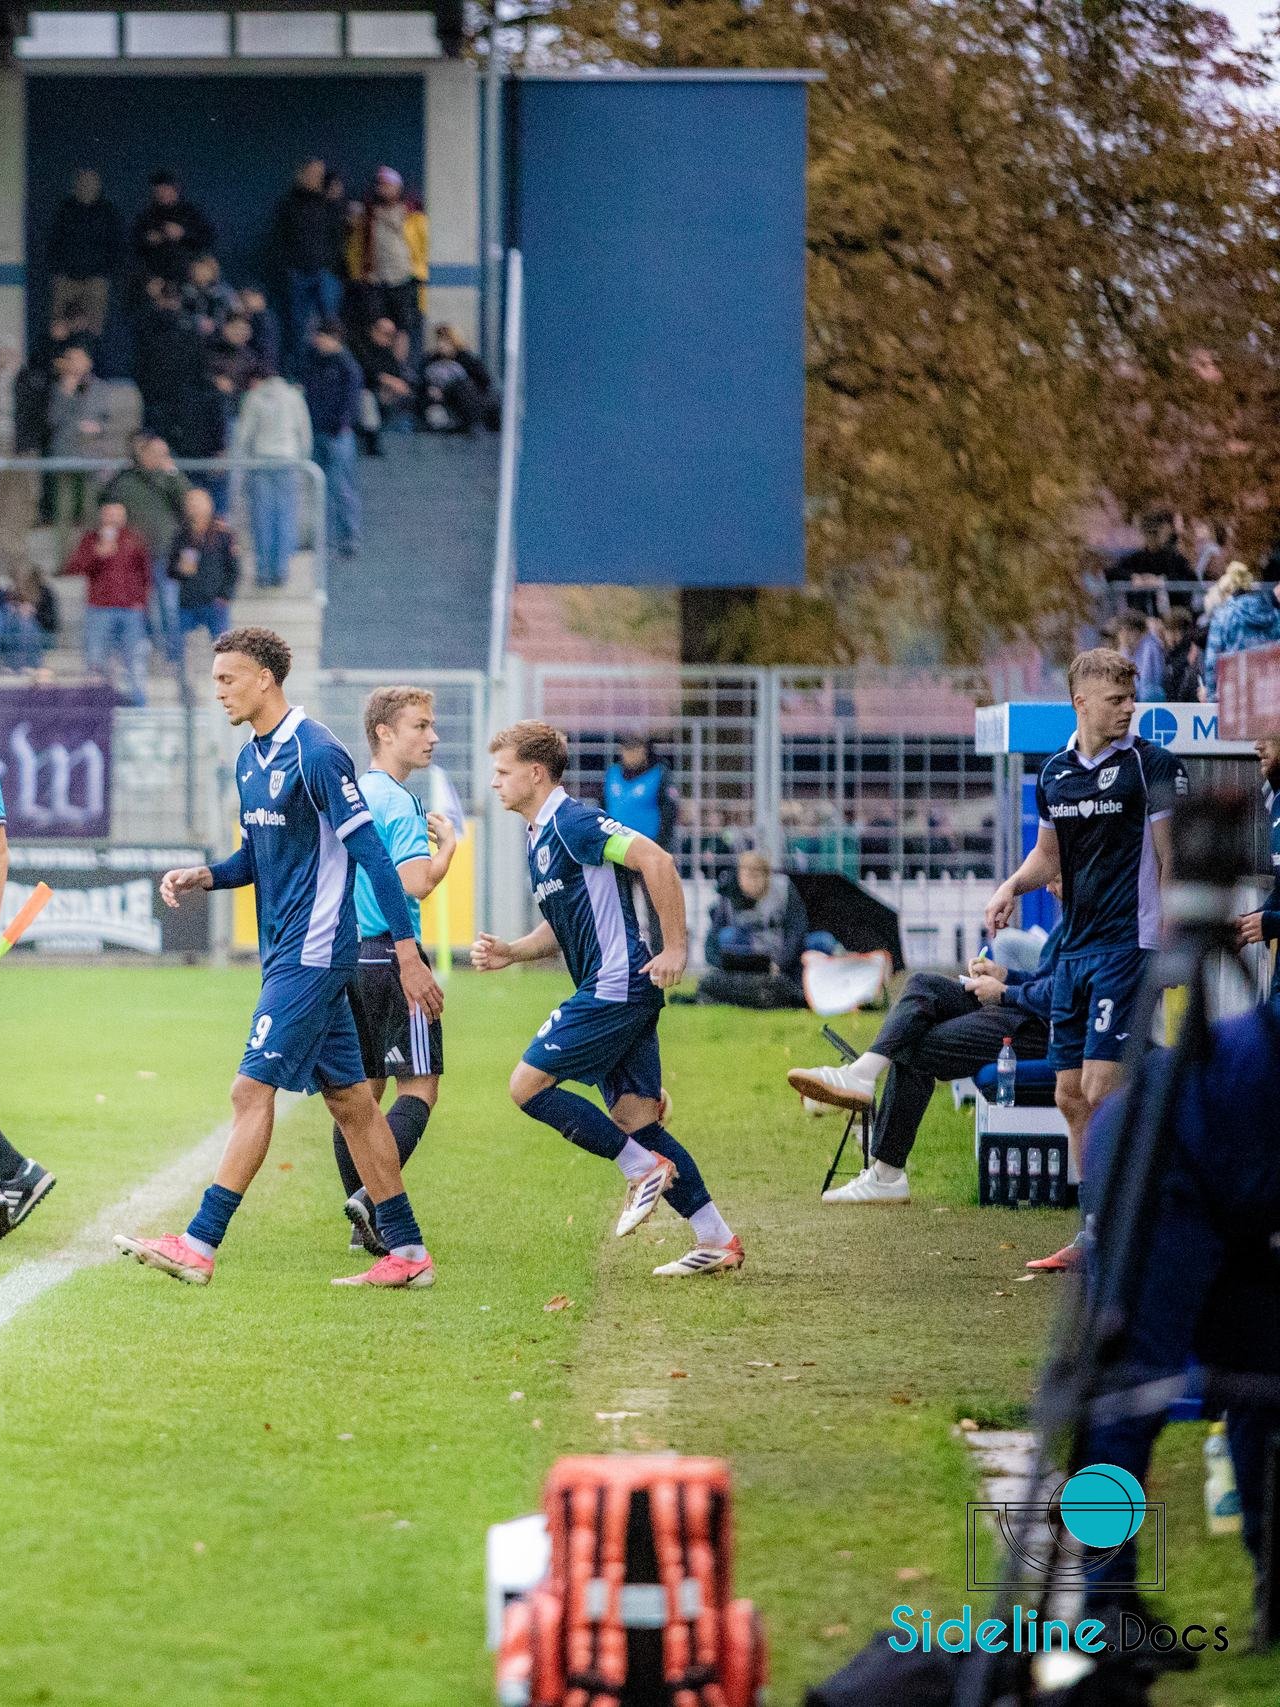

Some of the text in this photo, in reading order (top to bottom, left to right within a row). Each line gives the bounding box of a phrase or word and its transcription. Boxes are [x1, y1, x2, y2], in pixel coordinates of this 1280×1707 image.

[1094, 800, 1122, 815] Liebe
[537, 1009, 562, 1038] 6
[1094, 998, 1115, 1032] 3
[251, 1014, 273, 1049] 9
